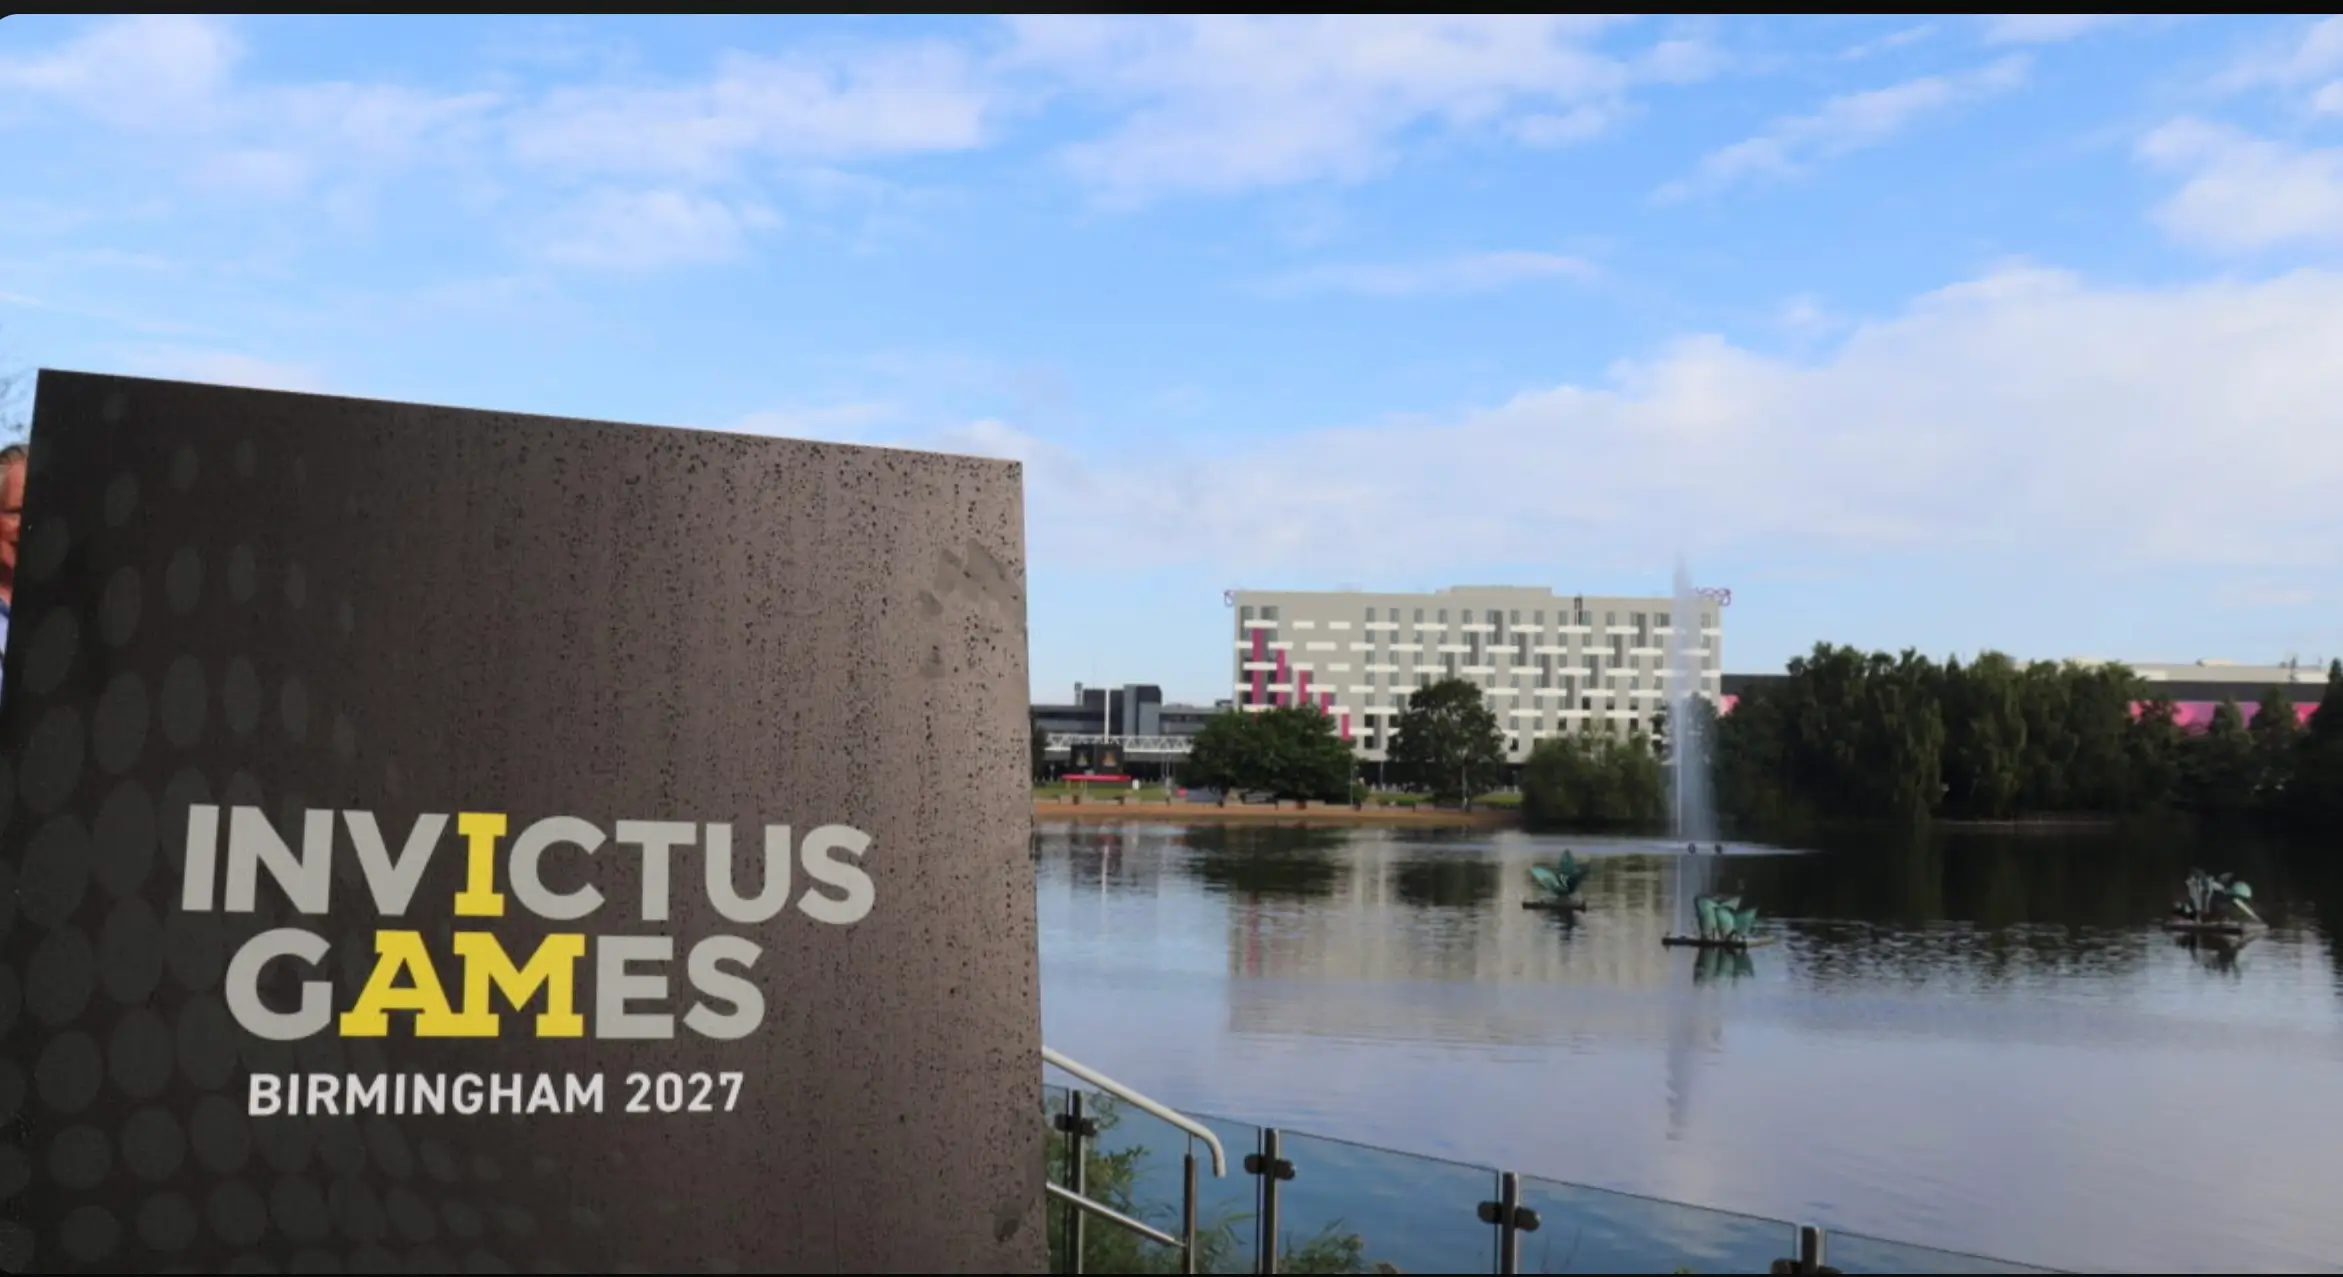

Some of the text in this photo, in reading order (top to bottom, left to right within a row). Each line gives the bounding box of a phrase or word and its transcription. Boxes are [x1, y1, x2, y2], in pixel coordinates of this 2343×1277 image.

[181, 803, 876, 924] INVICTUS
[225, 927, 765, 1040] GAMES
[248, 1072, 745, 1116] BIRMINGHAM 2027
